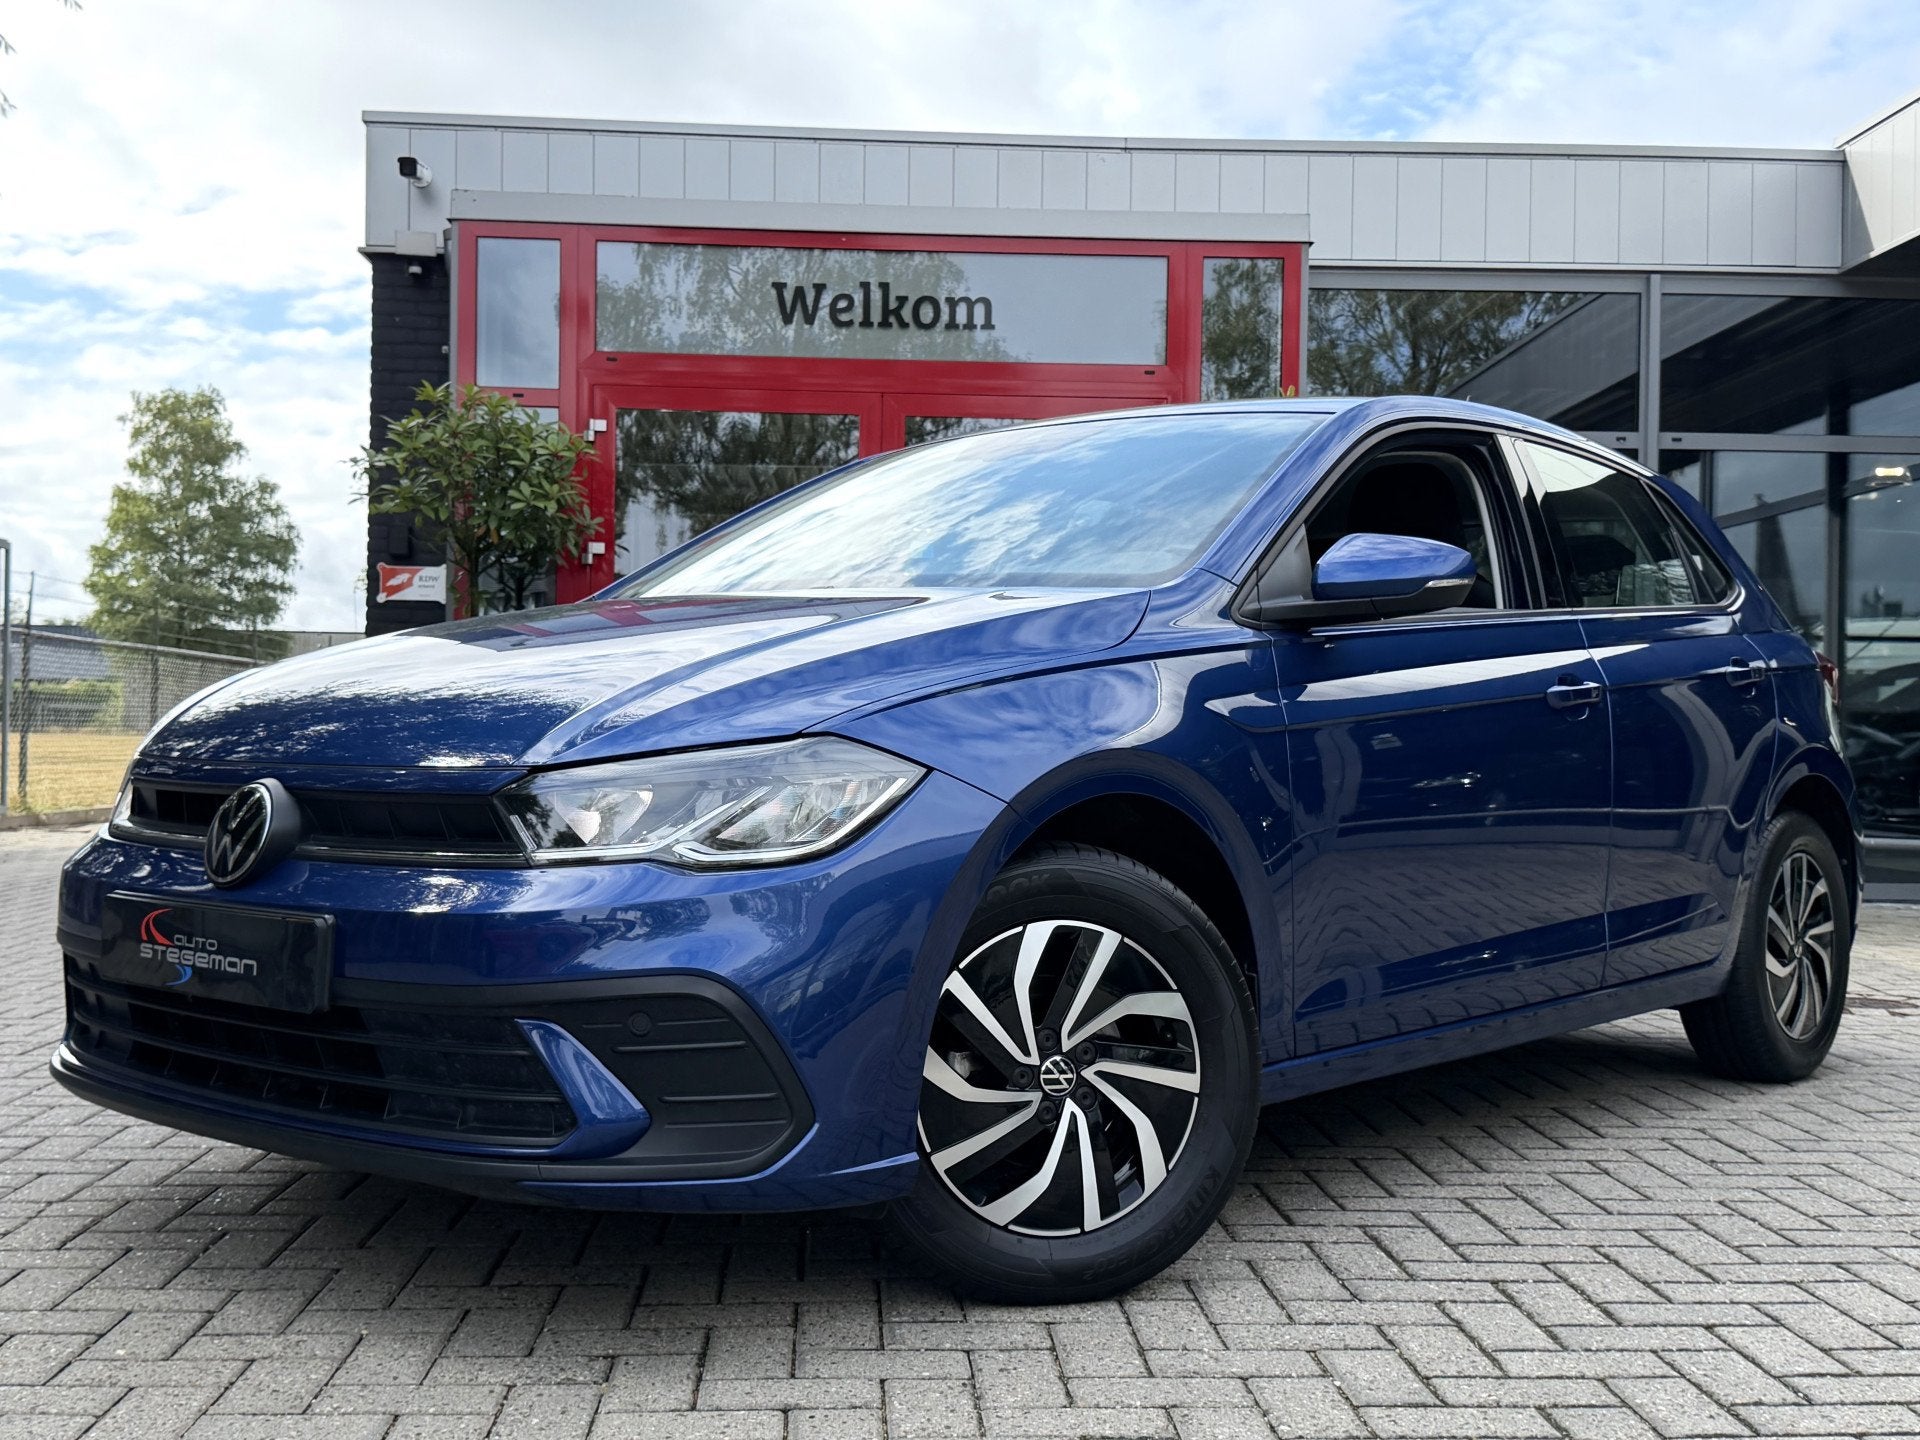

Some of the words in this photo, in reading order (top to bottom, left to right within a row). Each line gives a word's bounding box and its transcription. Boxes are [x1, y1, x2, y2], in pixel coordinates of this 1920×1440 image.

[771, 281, 996, 331] Welkom
[140, 942, 258, 977] STEGEMAN
[173, 934, 218, 951] AUTO
